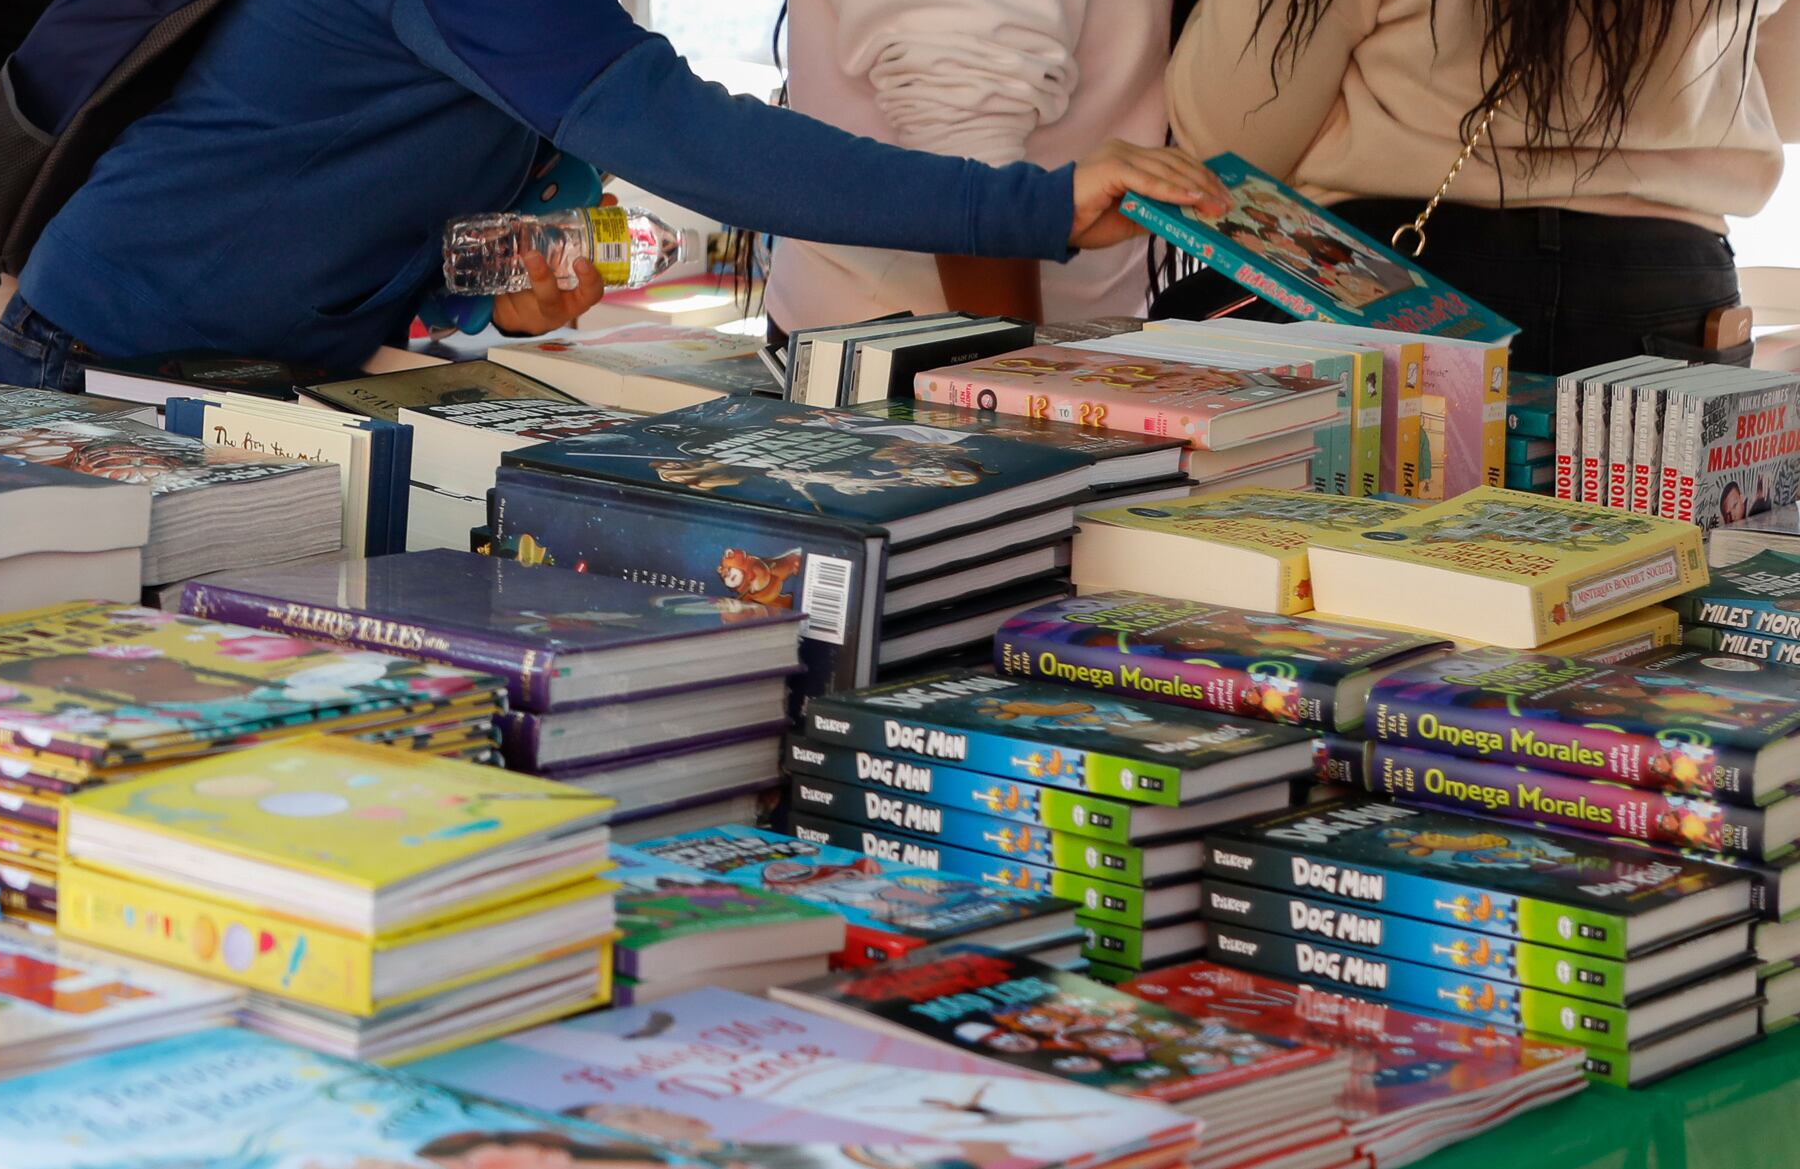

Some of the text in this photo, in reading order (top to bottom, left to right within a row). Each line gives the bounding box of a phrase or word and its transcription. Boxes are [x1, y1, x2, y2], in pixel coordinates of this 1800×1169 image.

[1025, 394, 1049, 420] 12
[1059, 408, 1070, 418] TO
[1739, 388, 1789, 412] NIKKI GRIMES
[214, 426, 238, 447] The
[1736, 405, 1787, 440] BRONX
[712, 431, 832, 465] STAR
[730, 434, 863, 469] WARS
[1707, 432, 1800, 473] MASQUERAD
[1557, 455, 1571, 499] BRON
[1584, 458, 1598, 502] BRON
[1611, 463, 1625, 507] BRON
[1678, 476, 1693, 522] BRON
[355, 616, 426, 651] TALES
[1699, 603, 1753, 628] MILES
[1720, 633, 1800, 665] MILES MO
[937, 675, 1021, 698] MAN
[1038, 651, 1204, 701] Omega Morales
[884, 719, 925, 753] DOG
[926, 730, 968, 761] MAN
[1377, 704, 1388, 740] LAEKAN
[1389, 714, 1397, 733] ZEA
[1399, 713, 1408, 739] KEMP
[1417, 713, 1605, 768] Omega Morales
[856, 752, 893, 783] DOG
[895, 763, 933, 793] MAN
[1384, 758, 1393, 793] LAEKAN
[1395, 769, 1404, 792] ZEA
[1405, 767, 1415, 793] KEMP
[865, 792, 903, 824] DOG
[904, 802, 942, 834] MAN
[1424, 769, 1613, 824] Omega Morales
[862, 832, 901, 861] DOG
[902, 842, 940, 871] MAN
[1291, 857, 1337, 893] DOG
[1339, 868, 1384, 901] MAN
[1289, 900, 1336, 936] DOG
[1338, 912, 1381, 946] MAN
[1296, 943, 1341, 980] DOG
[1343, 954, 1387, 990] MAN
